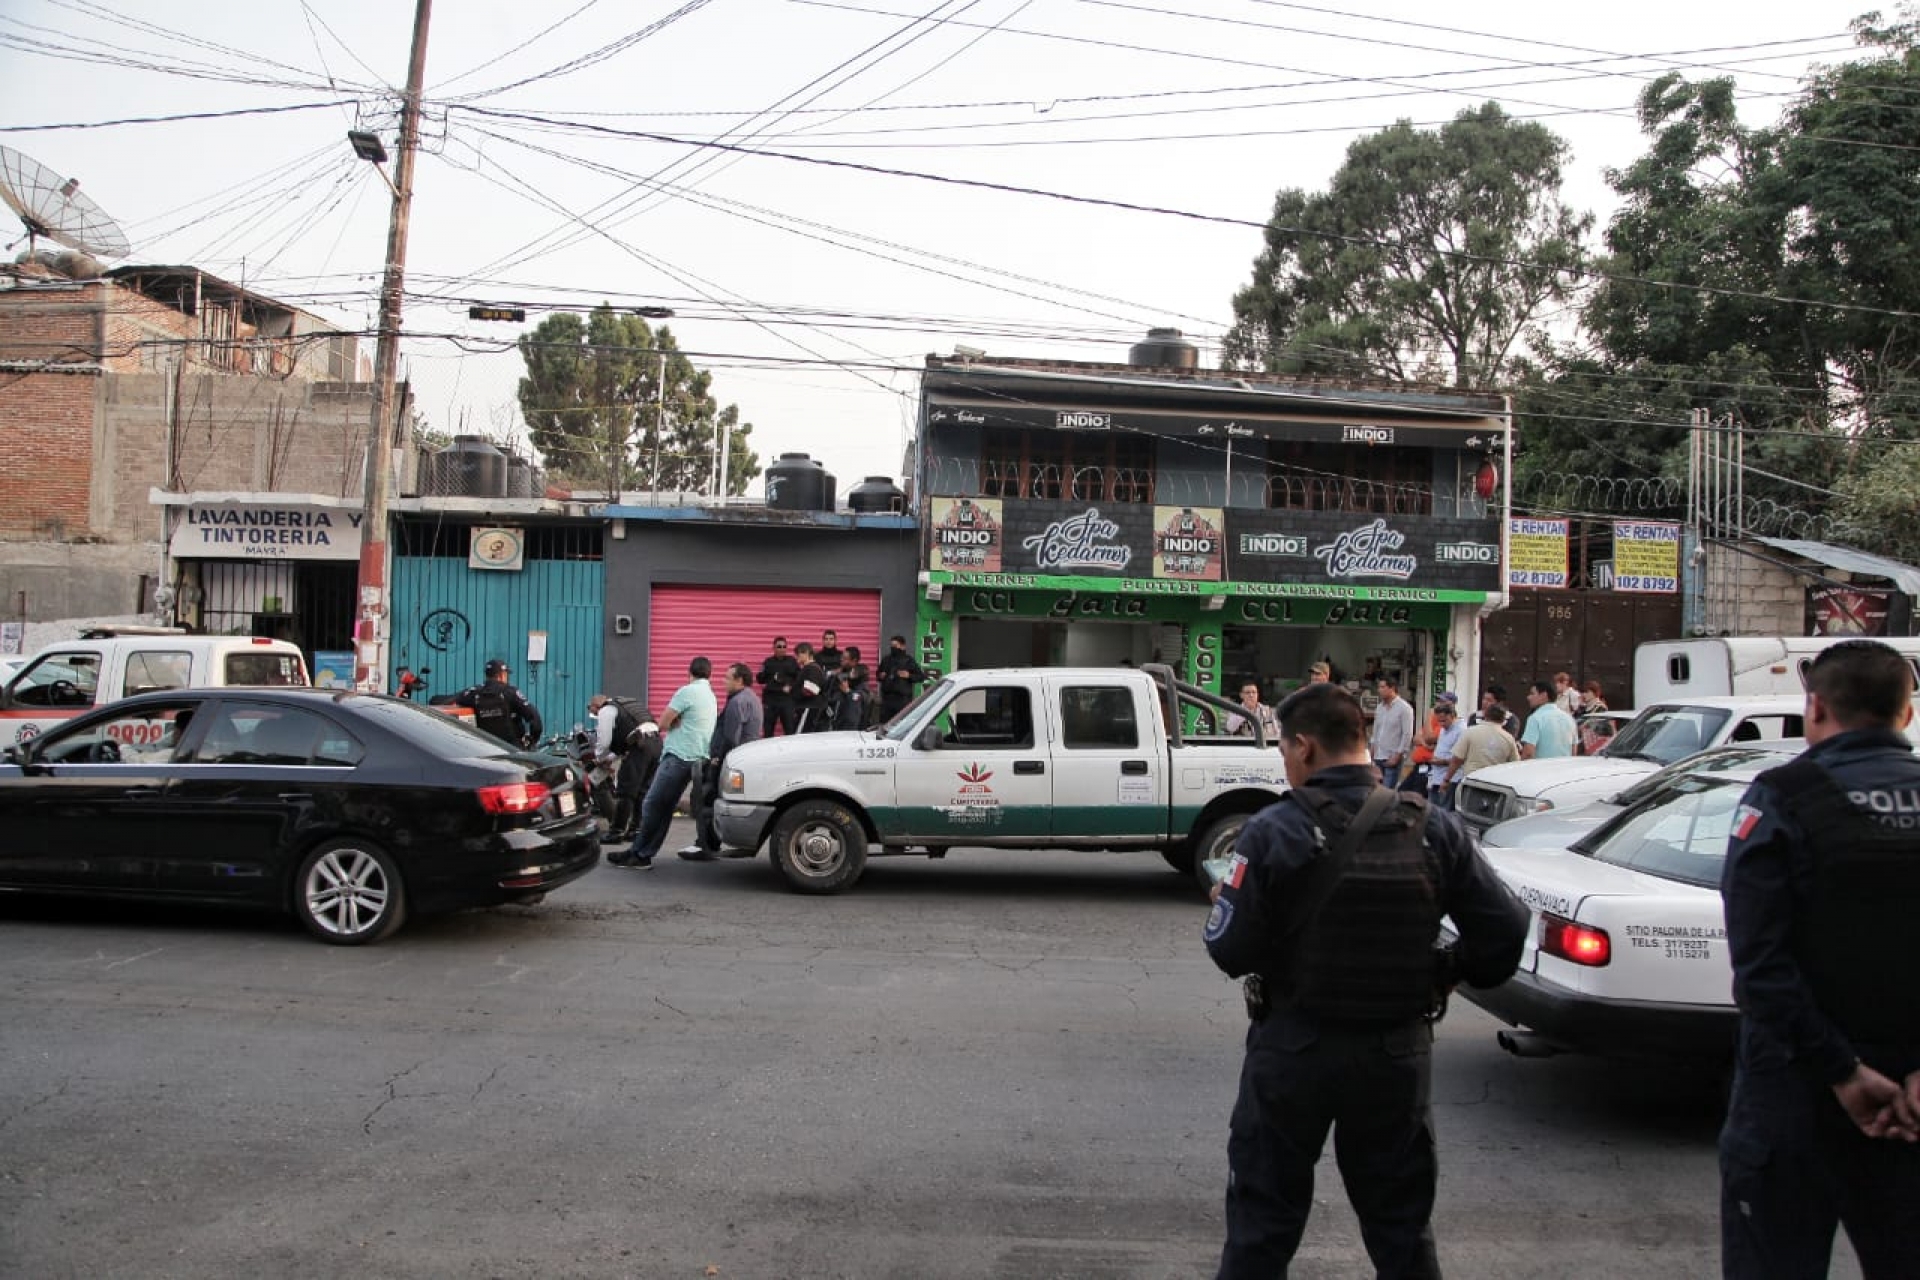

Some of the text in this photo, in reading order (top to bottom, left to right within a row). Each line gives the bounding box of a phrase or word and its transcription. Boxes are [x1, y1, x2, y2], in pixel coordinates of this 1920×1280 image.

[1062, 413, 1105, 427] INDIO
[1350, 428, 1388, 441] INDIO
[188, 509, 363, 529] LAVANDERIA Y
[1522, 519, 1566, 535] RENTAN
[1617, 525, 1678, 541] SE RENTAN
[201, 527, 331, 546] TINTORERIA
[942, 530, 990, 545] INDIO
[1164, 538, 1211, 552] INDIO
[1249, 537, 1298, 553] INDIO
[1443, 547, 1491, 561] INDIO
[952, 573, 1438, 600] INTERNET PLOTTER ENCUADERNADO TERMICO
[1531, 572, 1564, 586] 8792
[1617, 576, 1675, 591] 102 8792
[1547, 605, 1572, 619] 986
[858, 747, 895, 759] 1328
[1848, 788, 1920, 813] POLI
[1626, 925, 1650, 937] SITIO
[1653, 926, 1690, 938] PALOMA
[1691, 927, 1703, 938] DE
[1705, 928, 1717, 938] LA
